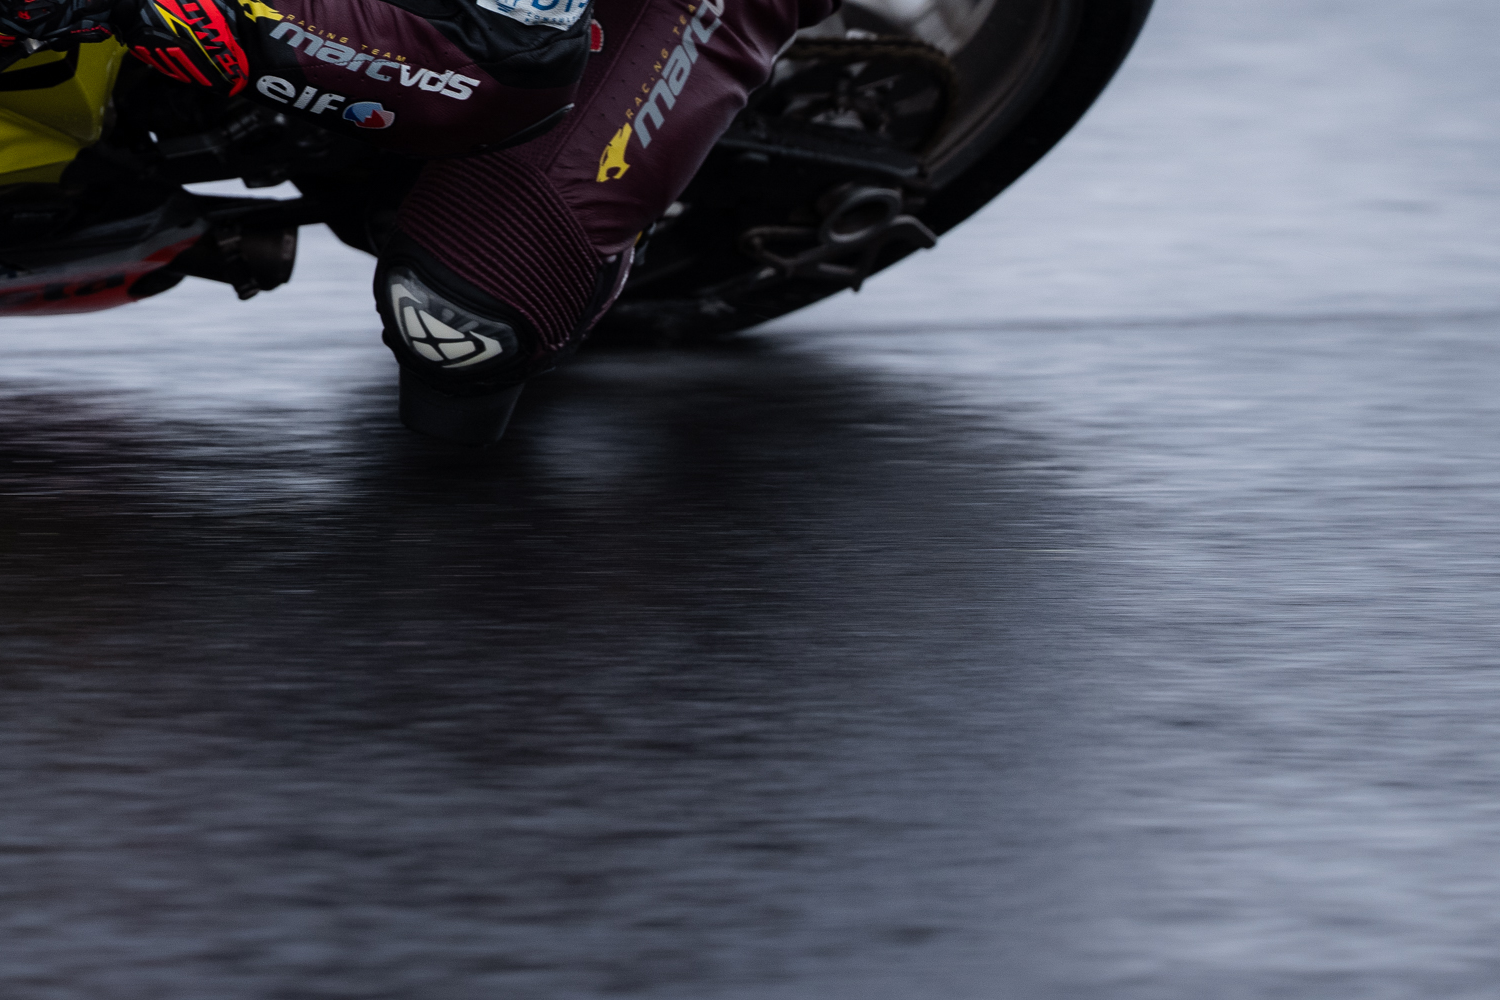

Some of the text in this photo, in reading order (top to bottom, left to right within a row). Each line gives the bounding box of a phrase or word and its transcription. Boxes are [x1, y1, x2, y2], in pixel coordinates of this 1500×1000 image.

[285, 13, 407, 63] RACING TEAM
[255, 74, 347, 115] elf
[625, 48, 669, 120] RACING
